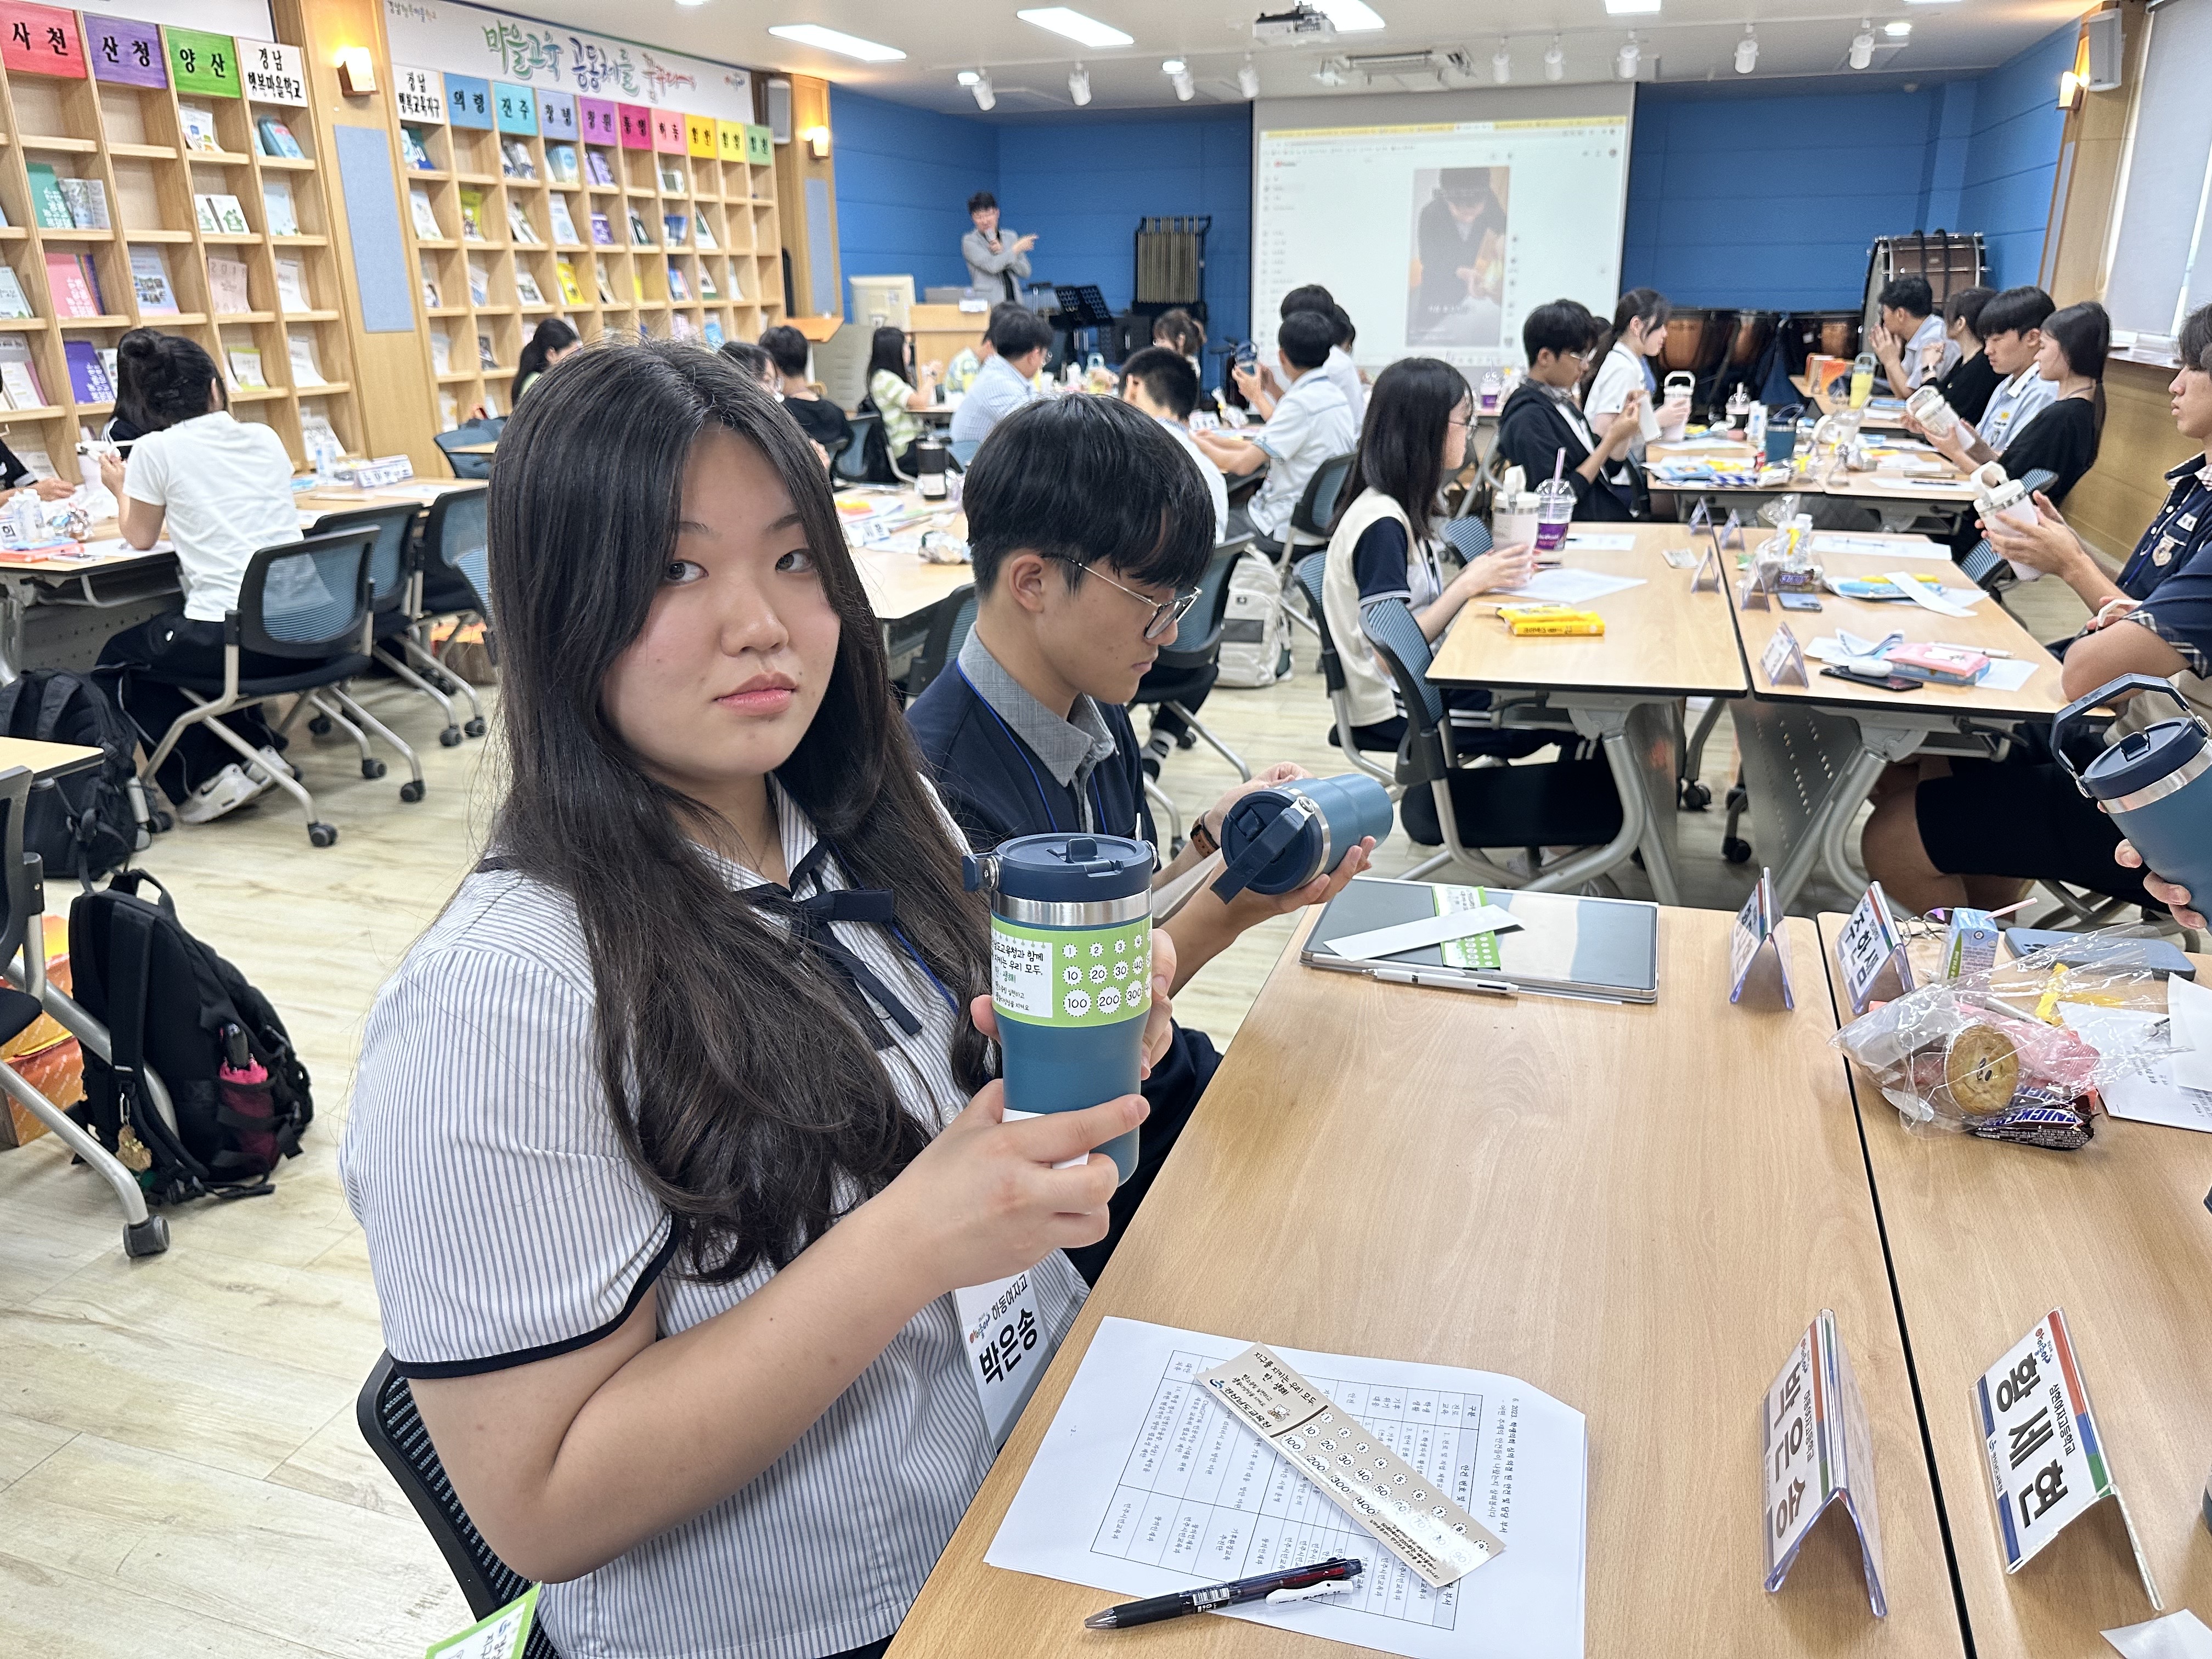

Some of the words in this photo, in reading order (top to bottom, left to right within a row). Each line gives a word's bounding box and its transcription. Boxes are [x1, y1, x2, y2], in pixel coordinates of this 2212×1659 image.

[12, 22, 68, 55] 사천
[481, 20, 563, 82] 마을교육
[179, 49, 225, 78] 양산
[258, 48, 283, 71] 경남
[247, 71, 302, 100] 행복마을학교
[1028, 950, 1043, 962] 함께
[1009, 961, 1022, 972] 우리
[1025, 964, 1043, 975] 모두.
[1067, 972, 1078, 980] 10
[1091, 970, 1105, 979] 20
[1115, 966, 1126, 975] 30
[1134, 961, 1143, 970] 40
[1068, 998, 1087, 1008] 100
[1099, 995, 1120, 1006] 200
[1127, 988, 1142, 1001] 300
[992, 1274, 1028, 1320] 하동여자고
[979, 1308, 1037, 1385] 박은송
[1254, 1352, 1273, 1368] 지구를
[1271, 1367, 1289, 1383] 지키는
[1289, 1383, 1303, 1393] 우리
[1301, 1392, 1316, 1406] 모두.
[1346, 1393, 1356, 1403] 안전
[1372, 1397, 1380, 1407] 대응
[1381, 1397, 1390, 1408] 위기
[1392, 1398, 1401, 1409] 기후
[1222, 1387, 1272, 1427] 경상남도교육청
[1412, 1401, 1420, 1412] 생활
[1422, 1402, 1431, 1412] 학생
[1441, 1403, 1449, 1414] 교육
[1452, 1404, 1460, 1415] 진로
[1468, 1406, 1476, 1417] 구분
[1498, 1406, 1506, 1415] 어떤
[2049, 1383, 2076, 1456] 삼현여자고등학교
[1404, 1435, 1411, 1444] 언어
[1508, 1423, 1516, 1443] 학생의회
[1419, 1437, 1428, 1457] 학생자치
[1442, 1440, 1449, 1449] 진로
[1996, 1353, 2069, 1529] 황세현
[1251, 1449, 1259, 1458] 기후
[1493, 1438, 1503, 1460] 안건들이
[1506, 1447, 1515, 1458] 심의
[1775, 1361, 1807, 1538] 박은송
[1247, 1461, 1255, 1470] 위기
[1305, 1426, 1316, 1435] 10
[1321, 1440, 1334, 1450] 20
[1339, 1455, 1352, 1465] 30
[1357, 1470, 1370, 1481] 40
[1375, 1485, 1388, 1496] 50
[1439, 1460, 1446, 1470] 직업
[1505, 1460, 1513, 1471] 의결
[1285, 1437, 1301, 1449] 100
[1306, 1457, 1325, 1471] 200
[1330, 1477, 1350, 1492] 300
[1356, 1497, 1375, 1514] 400
[1460, 1465, 1469, 1476] 안건
[1491, 1464, 1500, 1486] 나왔는지
[1459, 1481, 1467, 1492] 번호
[1503, 1484, 1511, 1494] 안건
[1500, 1507, 1509, 1518] 담당
[1499, 1521, 1508, 1533] 부서
[1173, 1517, 1191, 1553] 민주시민교육과
[1216, 1534, 1227, 1550] 추진단
[1223, 1528, 1238, 1560] 기후환경교육
[1375, 1558, 1390, 1596] 민주시민교육과
[1442, 1590, 1452, 1605] 부서
